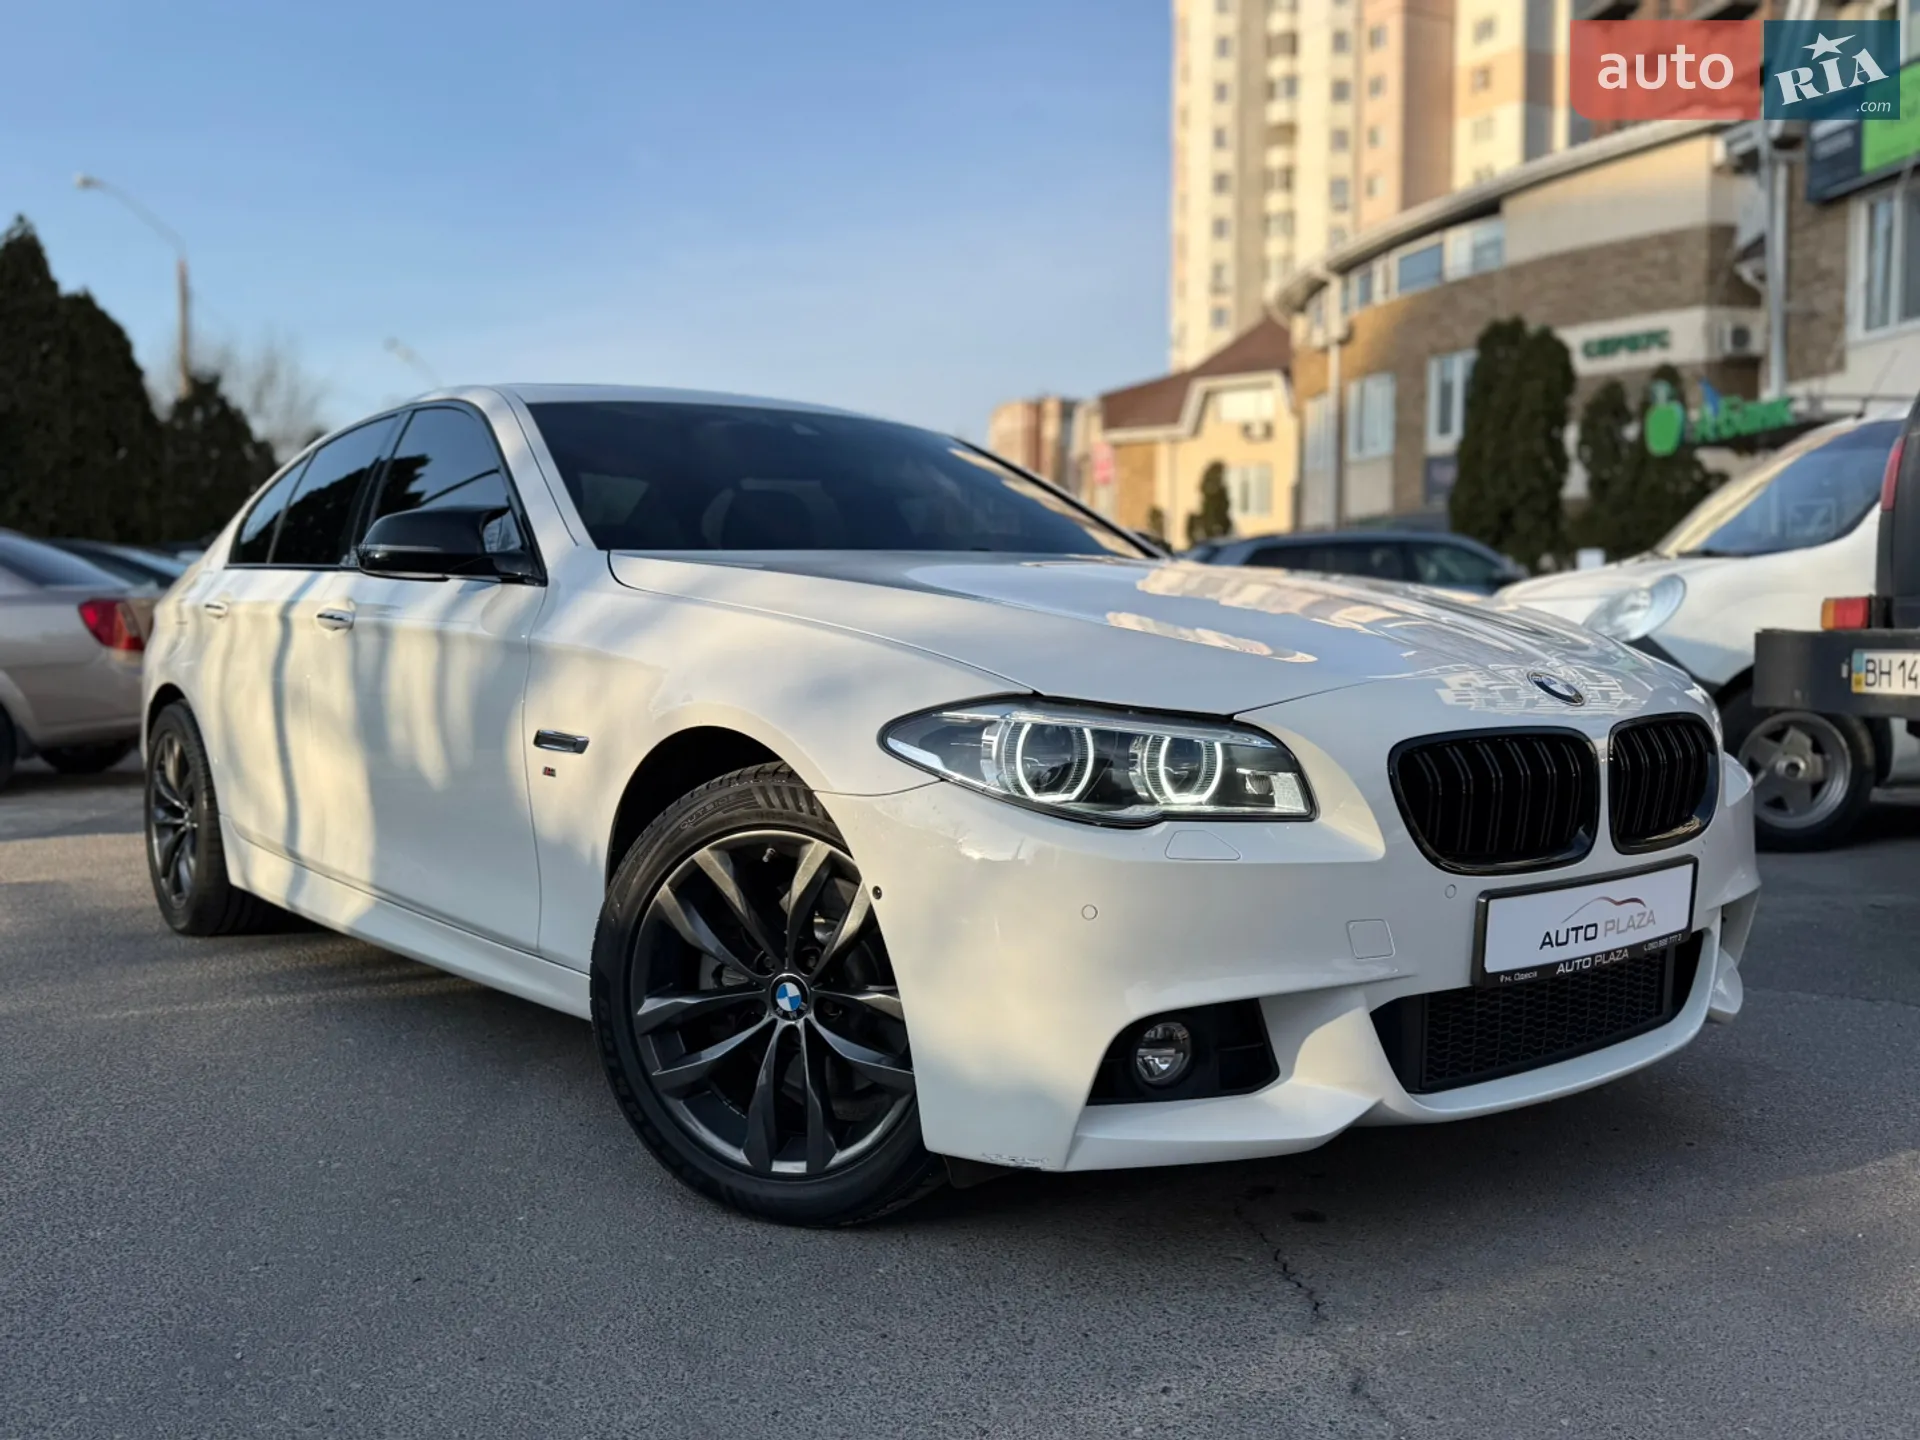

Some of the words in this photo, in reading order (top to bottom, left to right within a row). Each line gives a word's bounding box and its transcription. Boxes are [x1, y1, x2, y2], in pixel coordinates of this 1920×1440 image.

[1865, 658, 1892, 688] BH
[1538, 922, 1598, 950] AUTO
[1604, 909, 1656, 938] PLAZA
[1556, 957, 1592, 975] AUTO
[1594, 948, 1629, 967] PLAZA
